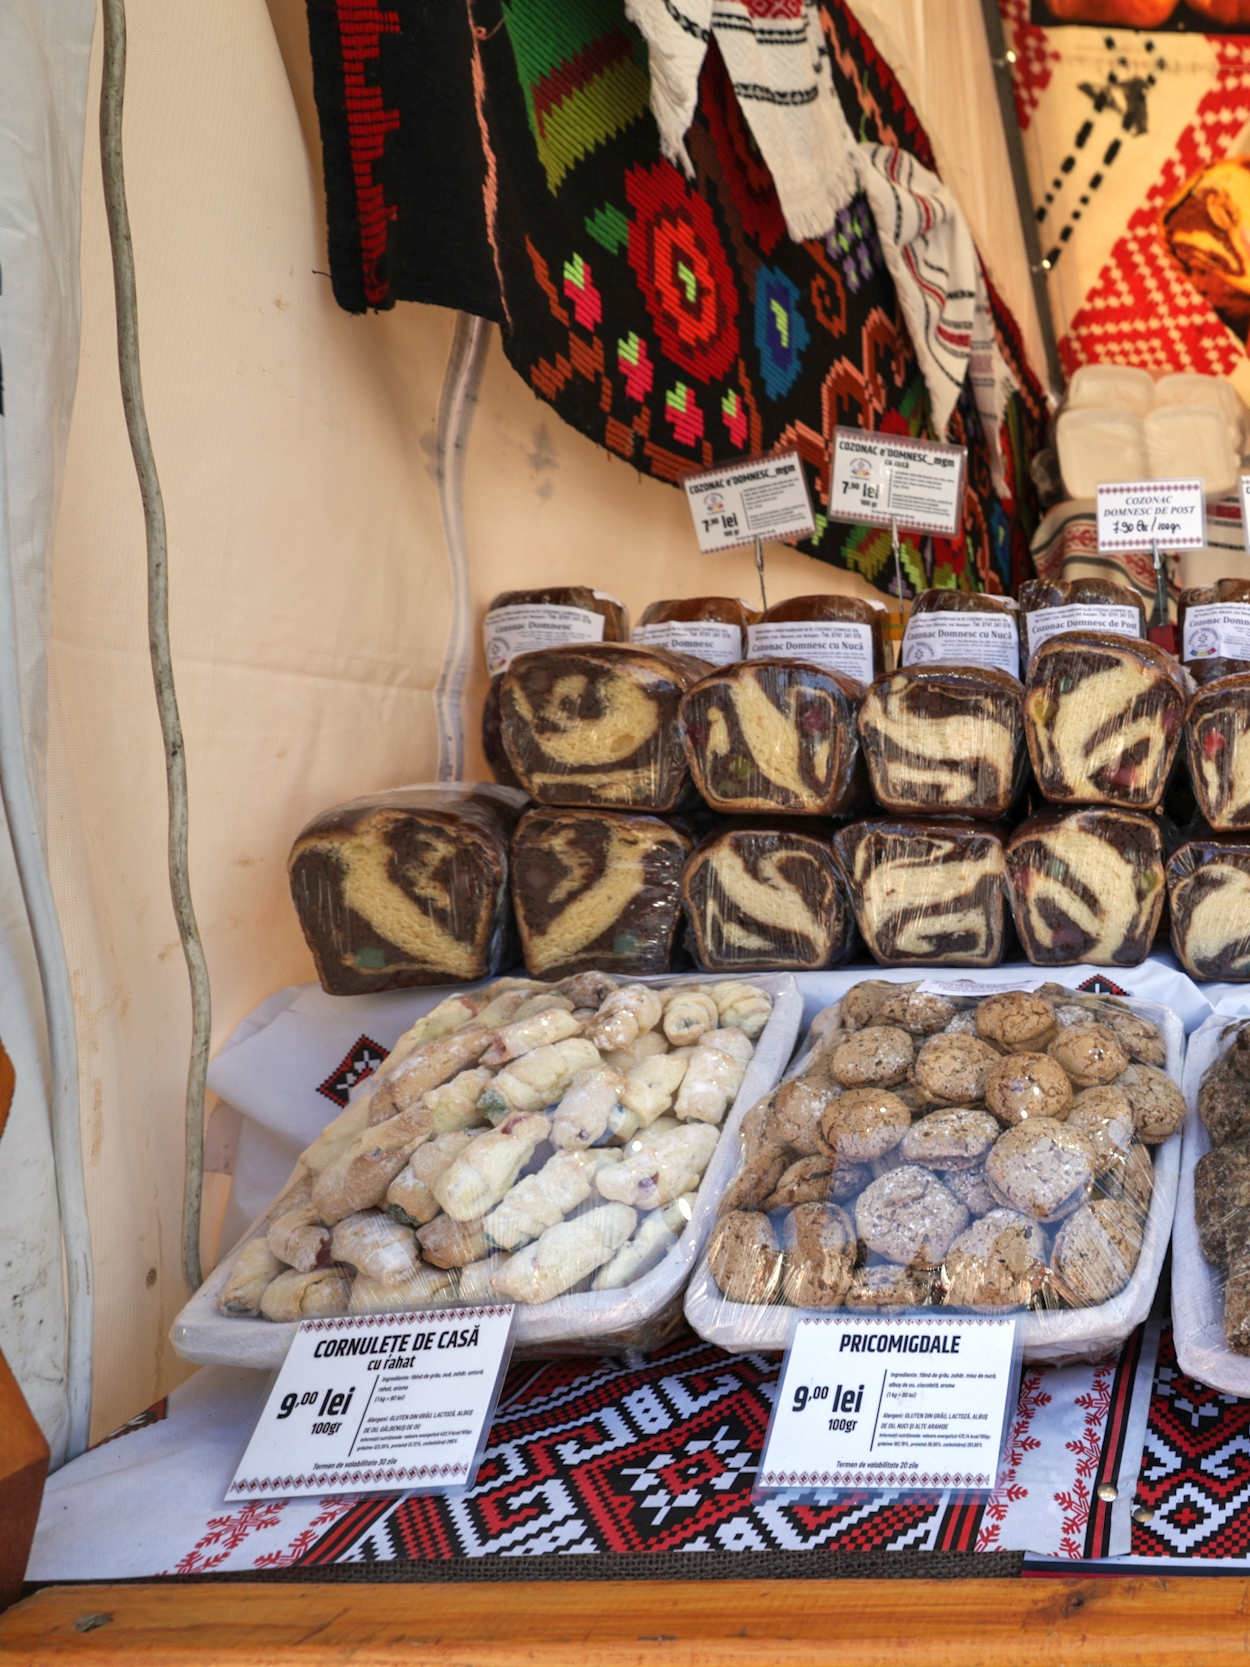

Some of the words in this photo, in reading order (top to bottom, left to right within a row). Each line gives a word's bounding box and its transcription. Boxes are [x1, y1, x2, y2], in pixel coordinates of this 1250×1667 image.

[839, 441, 878, 455] COZONAC
[689, 480, 725, 494] COZONAC
[862, 483, 879, 499] lei
[1125, 496, 1173, 505] COZONAC
[1104, 508, 1152, 517] DOMNESC
[1171, 506, 1195, 514] POST
[721, 513, 738, 529] lei
[495, 623, 525, 633] Cozonac
[528, 621, 572, 630] Domnesc
[1032, 622, 1064, 633] Cozonac
[1121, 621, 1137, 629] Post
[1190, 617, 1220, 627] Cozonac
[907, 631, 936, 640] Cozonac
[938, 630, 977, 638] Domnesc
[991, 631, 1011, 639] Nucă
[671, 640, 713, 648] Domnesc
[753, 643, 783, 652] Cozonac
[786, 642, 826, 650] Domnesc
[842, 641, 863, 650] Nucă
[314, 1334, 411, 1359] CORNULEȚE
[412, 1332, 436, 1351] DE
[437, 1325, 480, 1349] CASĂ
[839, 1334, 961, 1354] PRICOMIGDALE
[367, 1359, 382, 1371] cu
[383, 1355, 416, 1370] rahat
[276, 1391, 319, 1420] 9,00
[318, 1387, 356, 1417] lei
[792, 1385, 828, 1412] 9,00
[832, 1384, 865, 1413] lei
[311, 1421, 342, 1436] 100gr
[828, 1419, 858, 1432] 100gr
[345, 1460, 377, 1468] valabilitate
[836, 1461, 857, 1469] Termen
[858, 1461, 865, 1469] de
[867, 1461, 899, 1469] valabilitate
[900, 1461, 908, 1469] 20
[909, 1461, 918, 1469] zile
